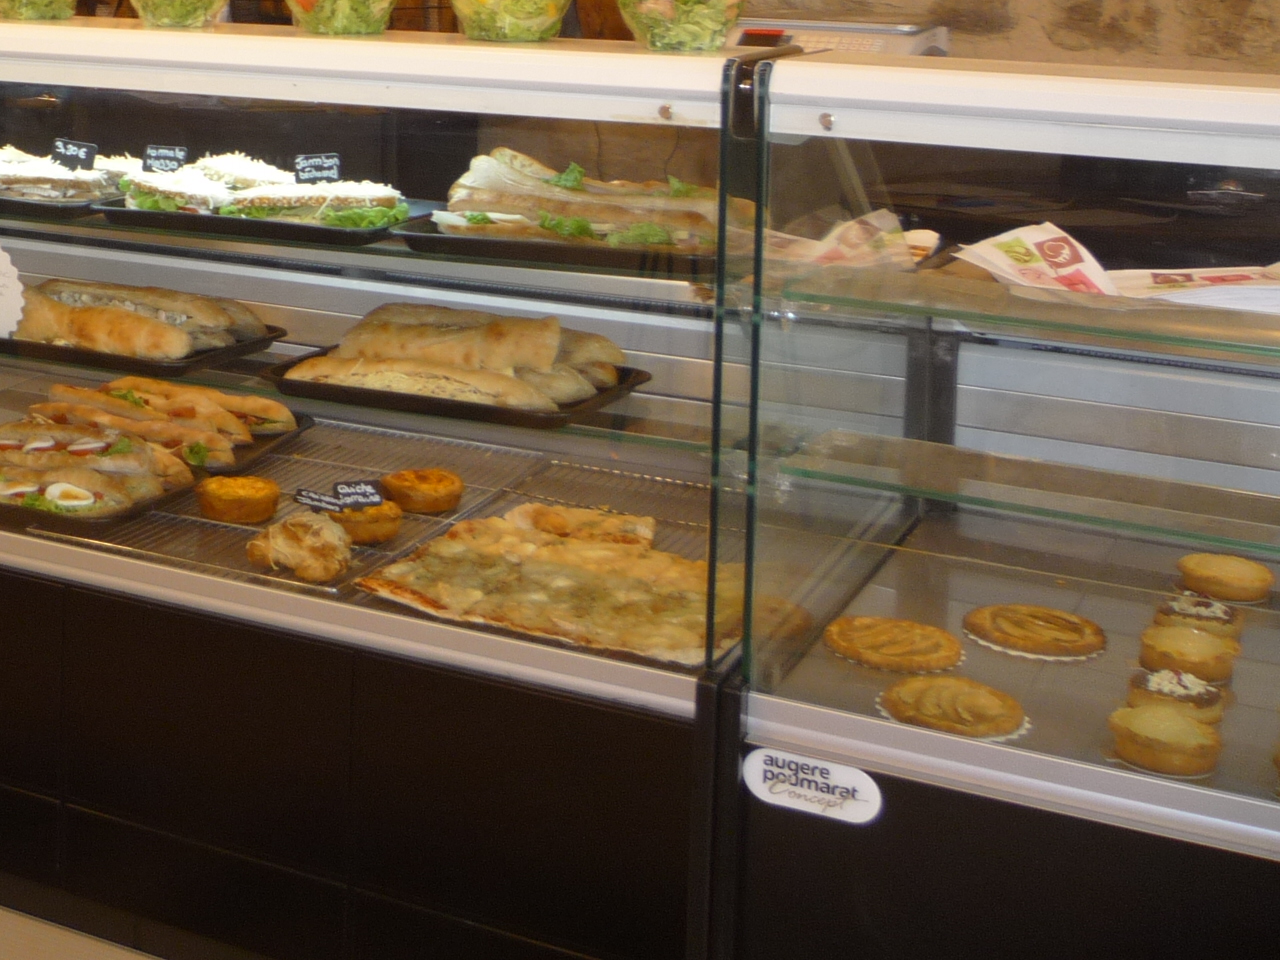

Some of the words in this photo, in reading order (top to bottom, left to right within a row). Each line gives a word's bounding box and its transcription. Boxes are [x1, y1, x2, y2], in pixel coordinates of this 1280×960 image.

[337, 482, 376, 493] Quiche
[763, 754, 831, 780] augere
[762, 767, 859, 800] poumarat
